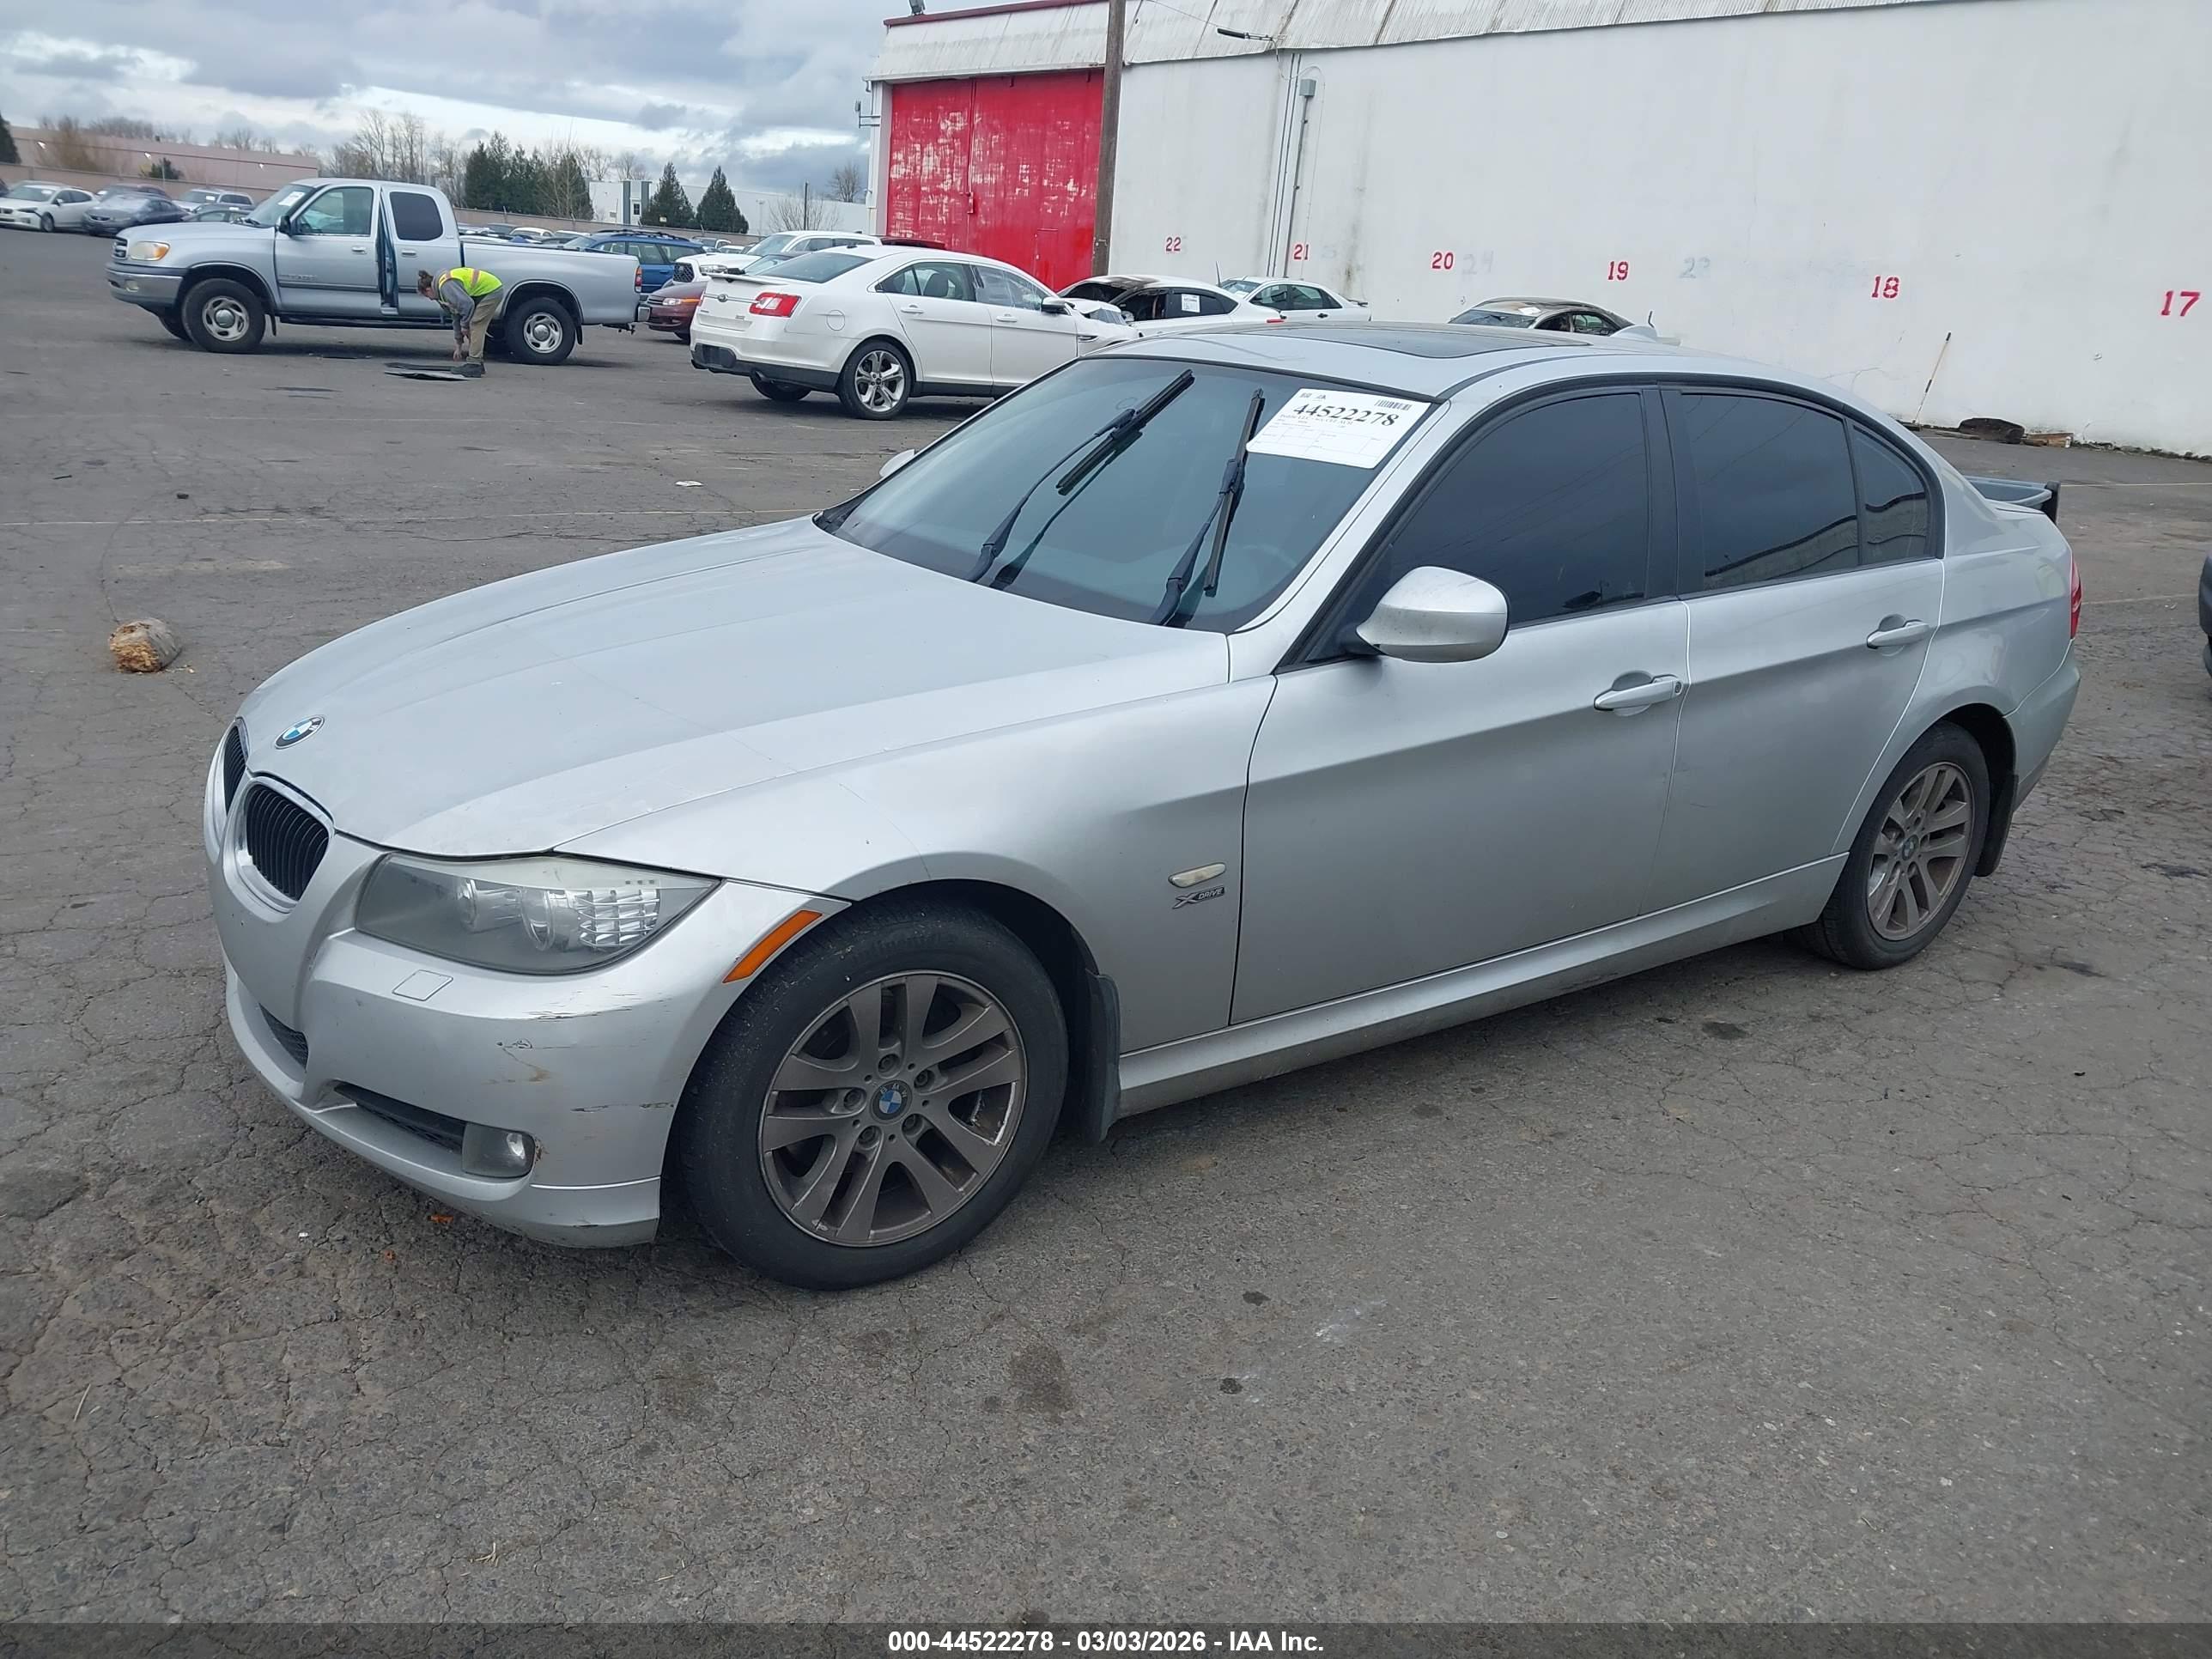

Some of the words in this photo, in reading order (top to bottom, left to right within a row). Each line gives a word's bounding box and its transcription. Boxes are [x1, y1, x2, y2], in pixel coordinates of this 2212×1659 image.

[1165, 236, 1182, 252] 22
[1294, 244, 1310, 260] 21
[1431, 252, 1454, 270] 20
[1608, 261, 1629, 281] 19
[1872, 276, 1899, 299] 18
[2161, 290, 2201, 317] 17
[1293, 403, 1399, 427] 44522278
